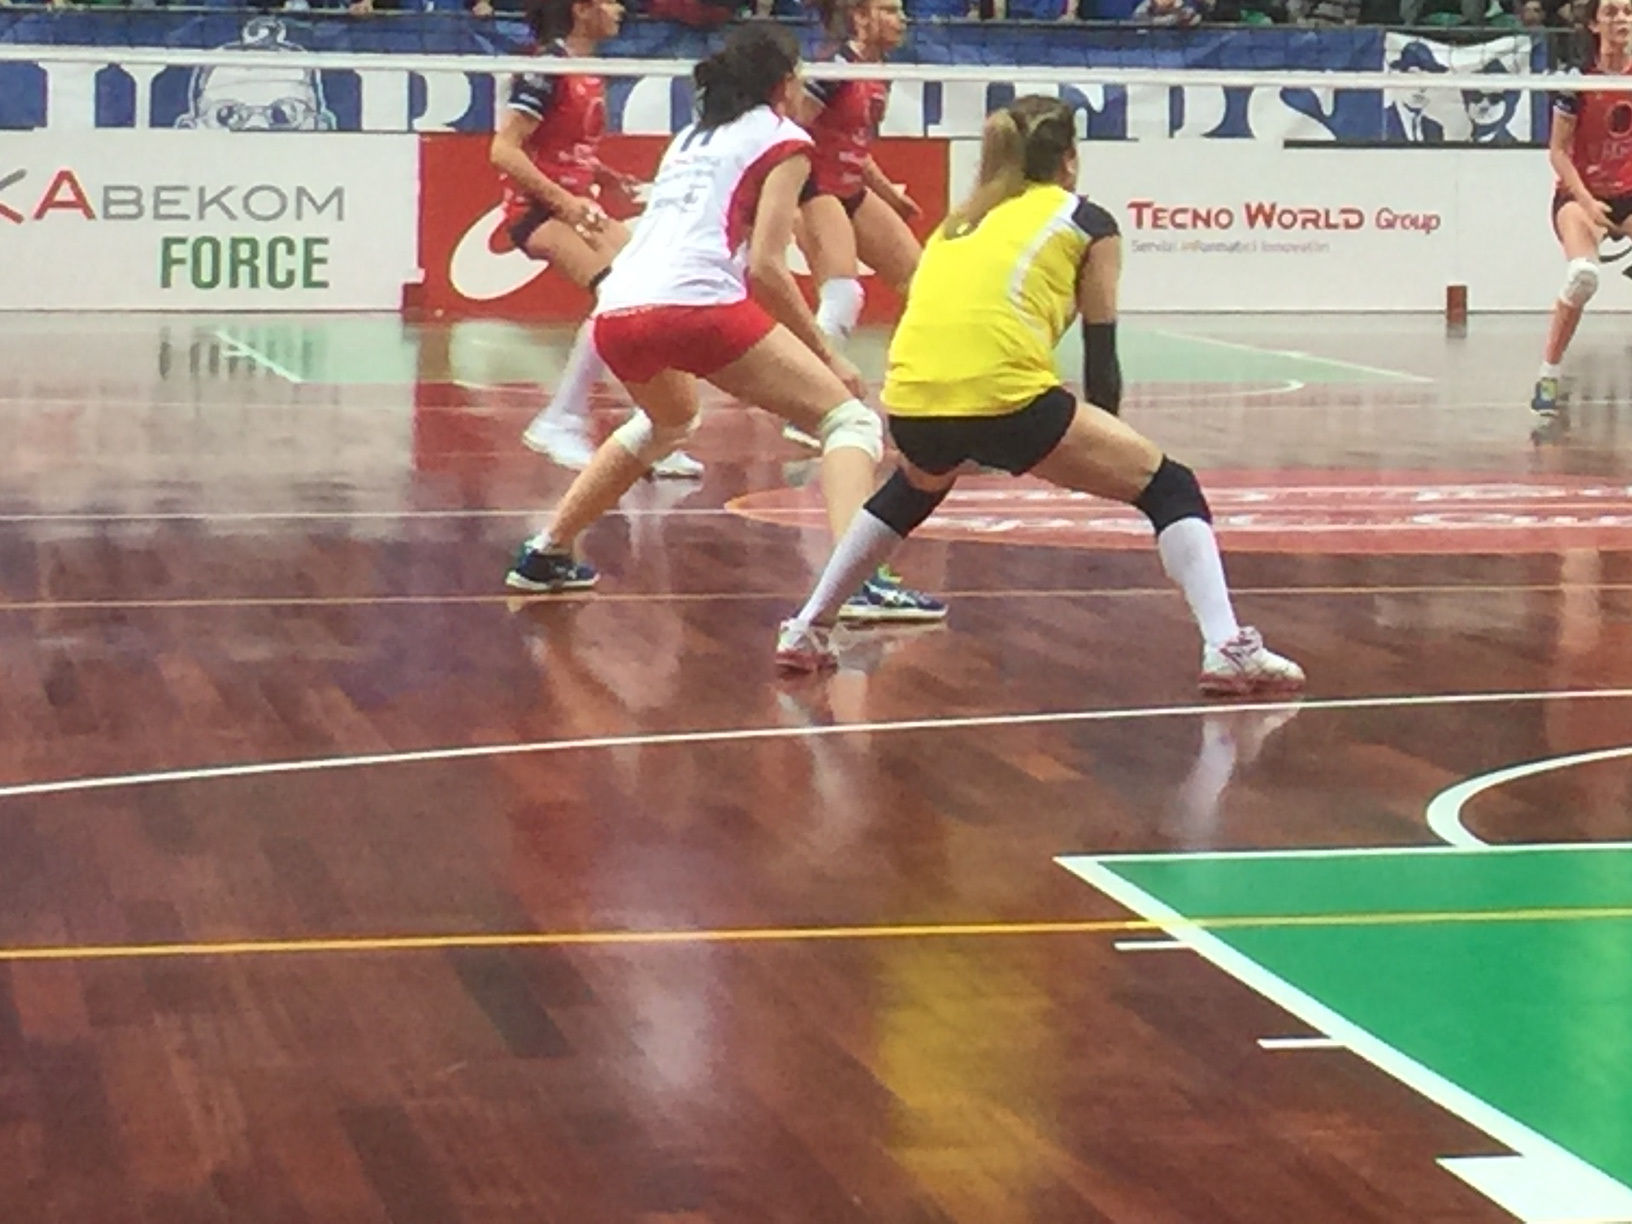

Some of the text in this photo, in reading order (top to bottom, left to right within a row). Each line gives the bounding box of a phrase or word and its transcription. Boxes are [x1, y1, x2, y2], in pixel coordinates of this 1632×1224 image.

[1127, 201, 1441, 235] TECNO WORLD Group
[159, 235, 331, 290] FORCE
